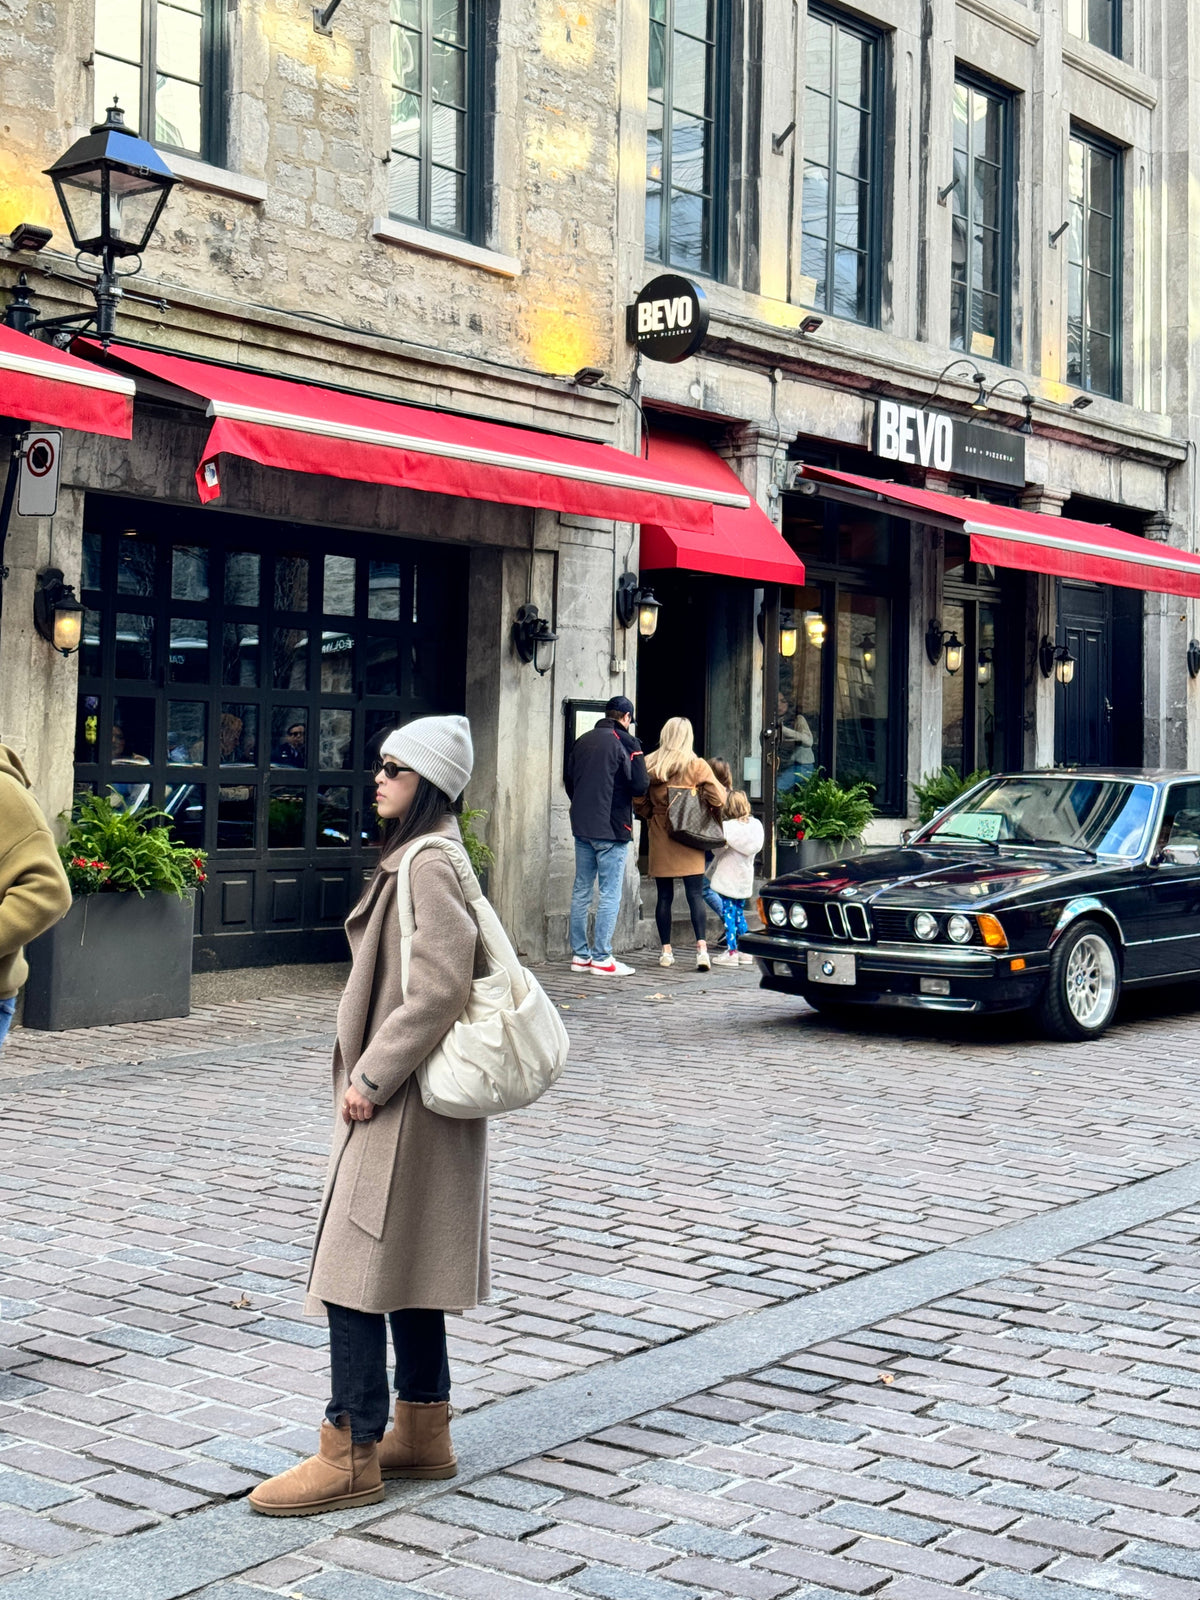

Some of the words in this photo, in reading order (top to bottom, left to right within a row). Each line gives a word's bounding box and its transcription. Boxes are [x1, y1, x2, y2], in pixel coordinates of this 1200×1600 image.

[638, 295, 693, 333] BEVO
[661, 329, 692, 337] PIZZERIA
[879, 399, 953, 472] BEVO
[965, 445, 977, 454] BAR
[985, 450, 1013, 462] PIZZERIA
